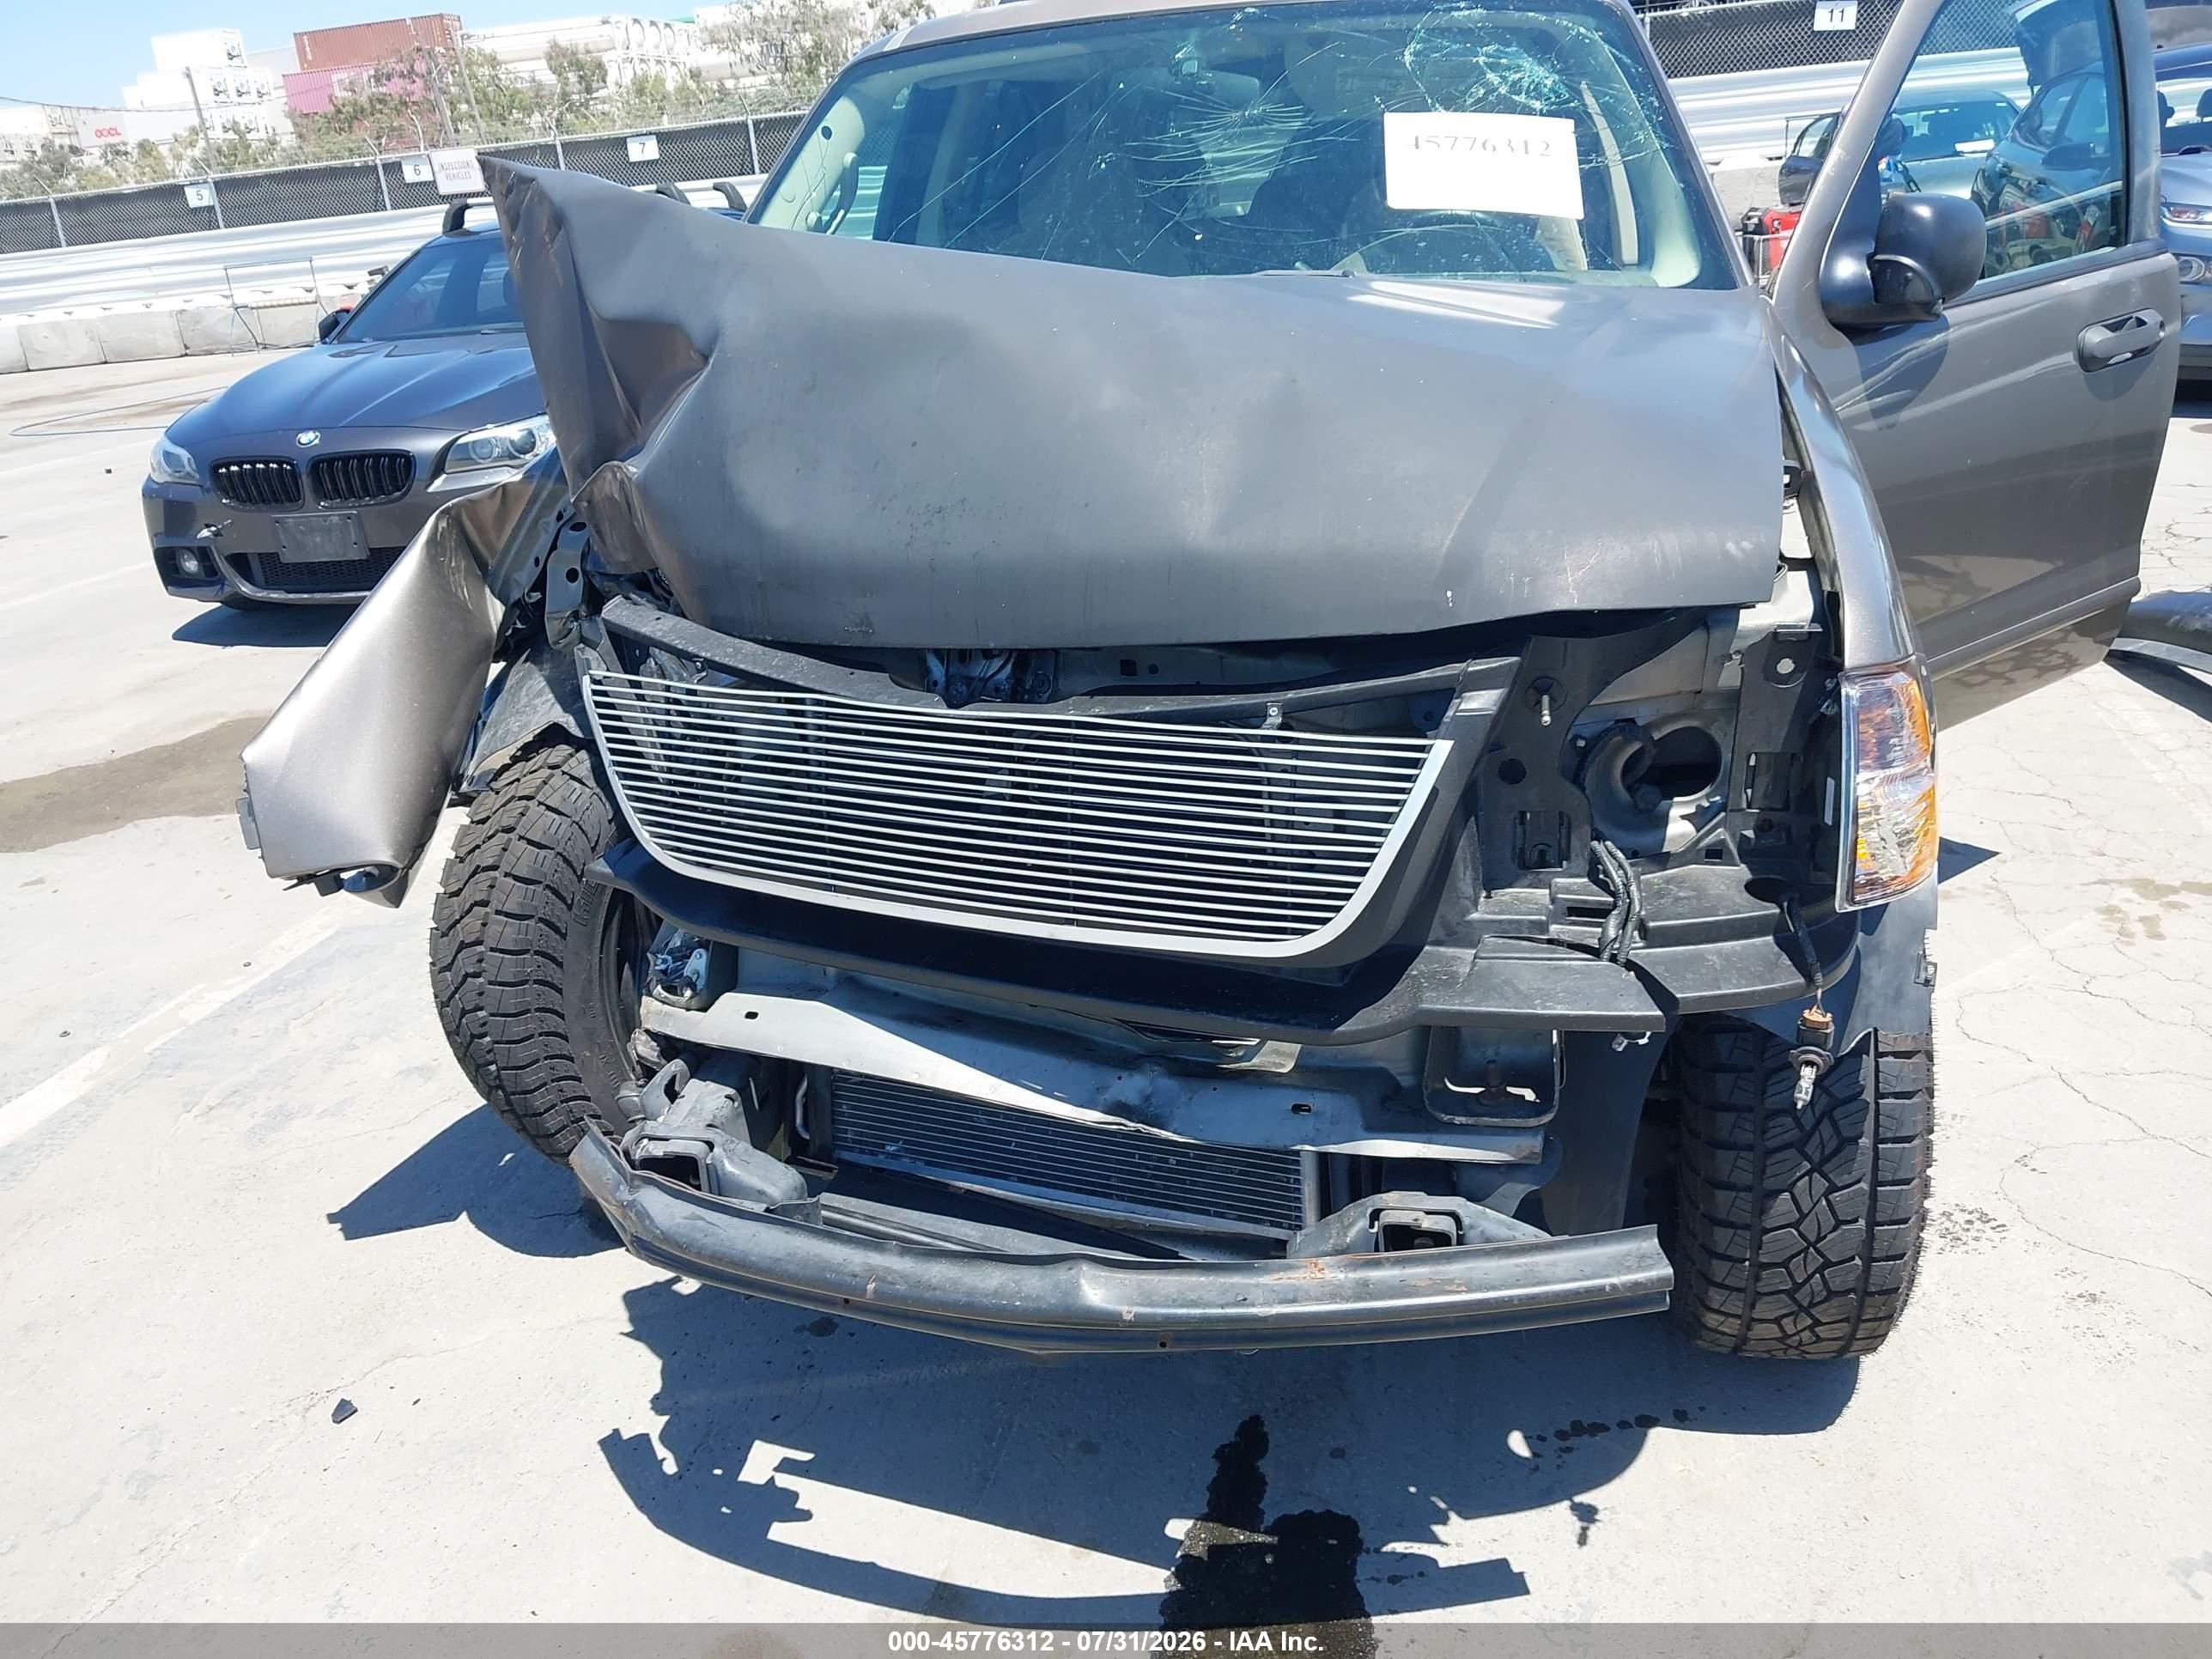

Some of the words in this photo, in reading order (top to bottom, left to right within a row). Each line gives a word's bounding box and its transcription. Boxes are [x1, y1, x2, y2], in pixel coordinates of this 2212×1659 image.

[1828, 8, 1844, 22] 11
[94, 125, 122, 138] OOCL
[638, 142, 646, 155] 7
[413, 164, 422, 177] 6
[196, 189, 204, 201] 5
